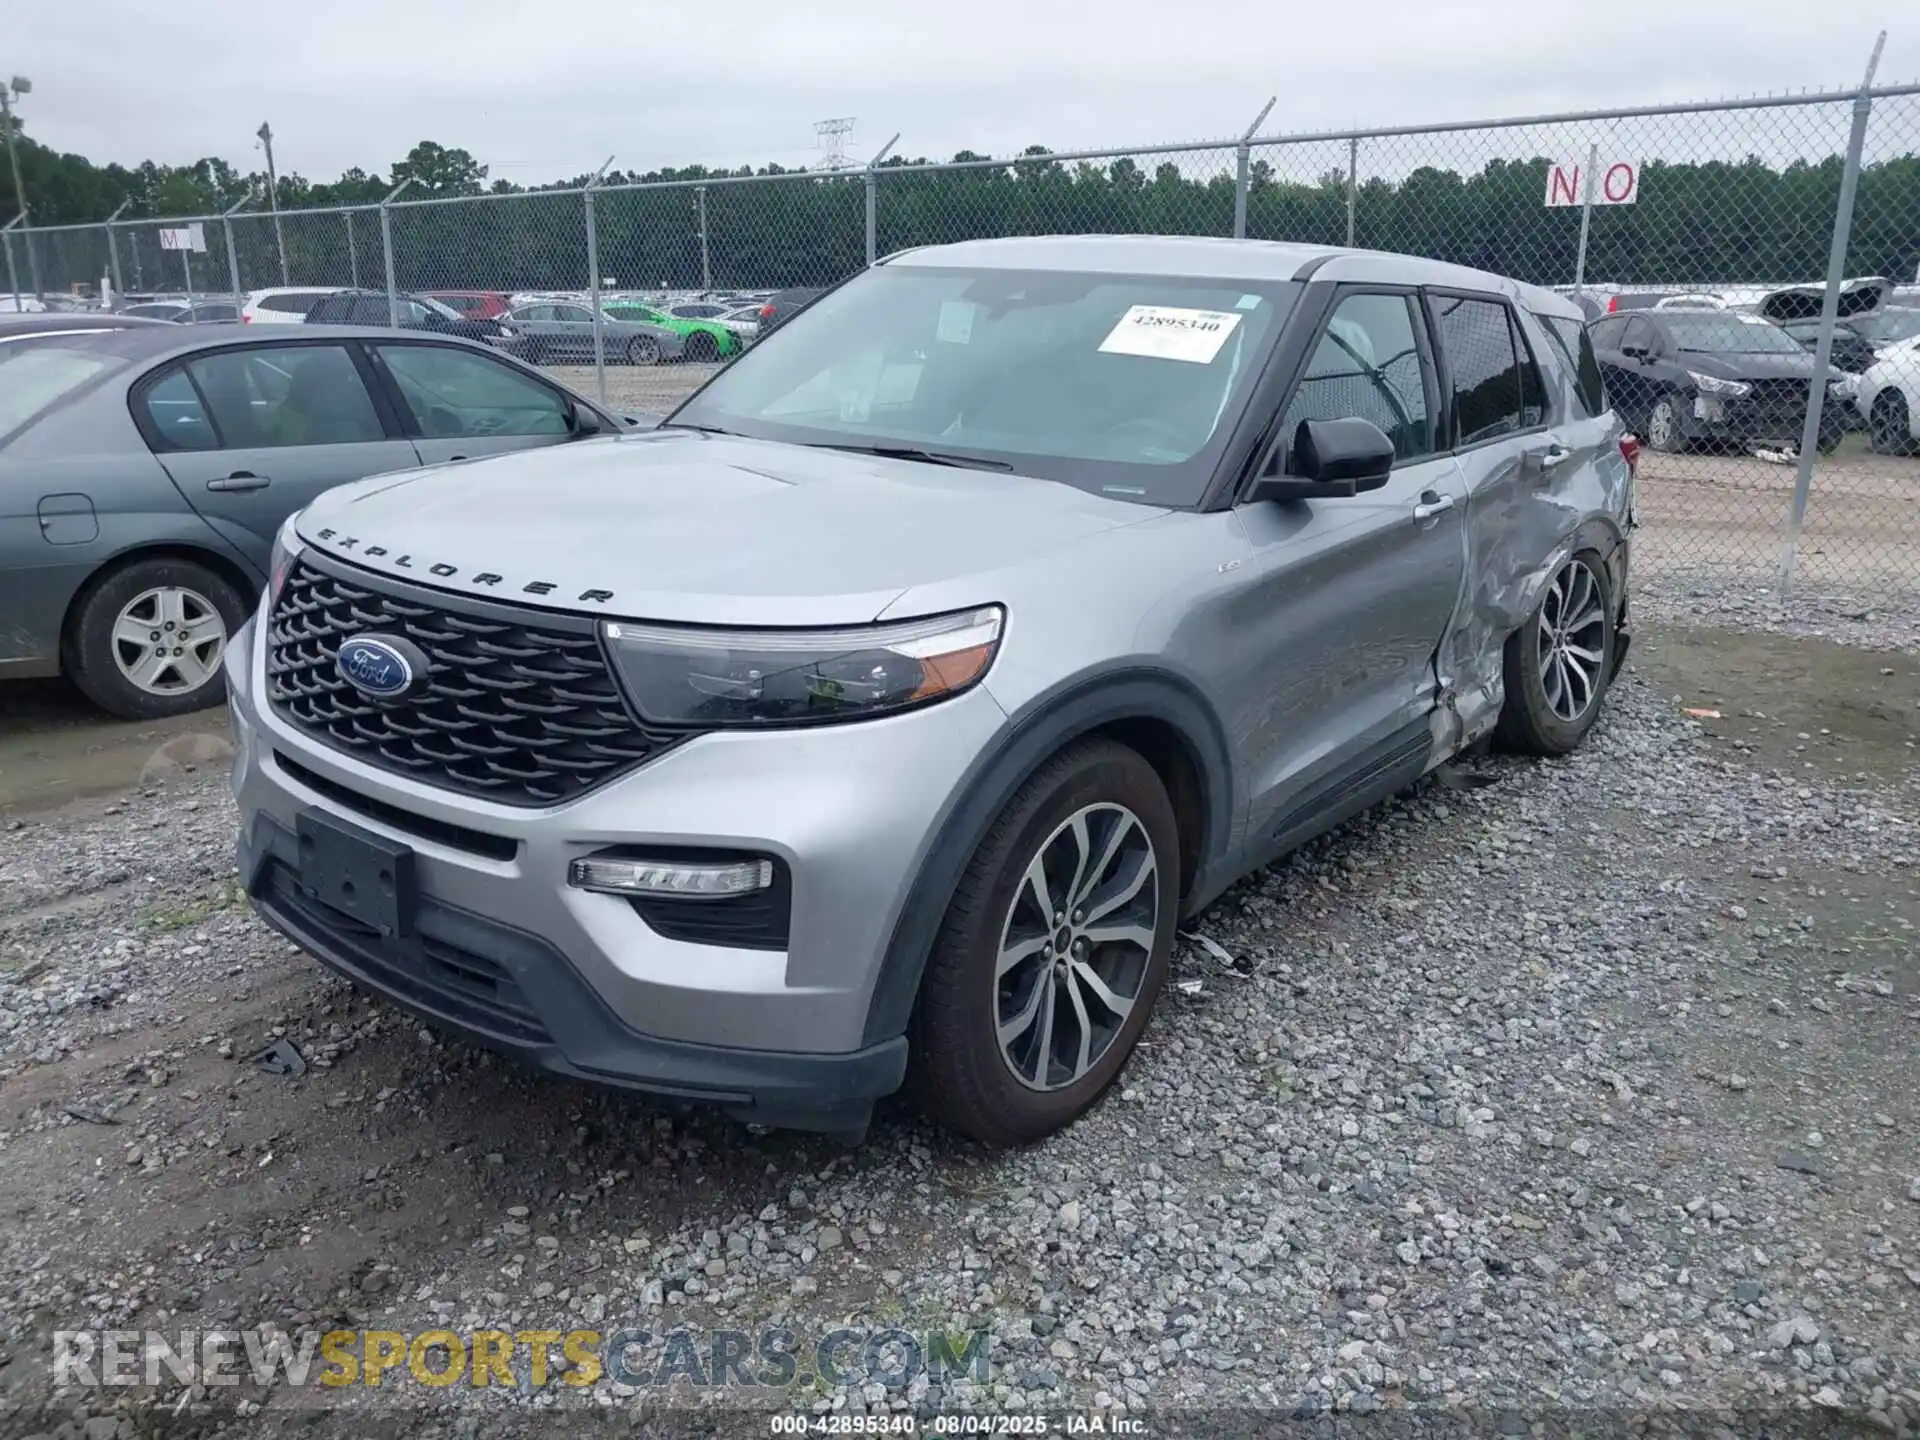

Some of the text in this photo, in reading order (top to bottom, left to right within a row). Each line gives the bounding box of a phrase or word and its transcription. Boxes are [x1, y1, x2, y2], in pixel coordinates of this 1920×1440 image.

[1132, 315, 1221, 332] 42895340
[316, 528, 615, 603] EXPLORER
[348, 647, 391, 685] Ford
